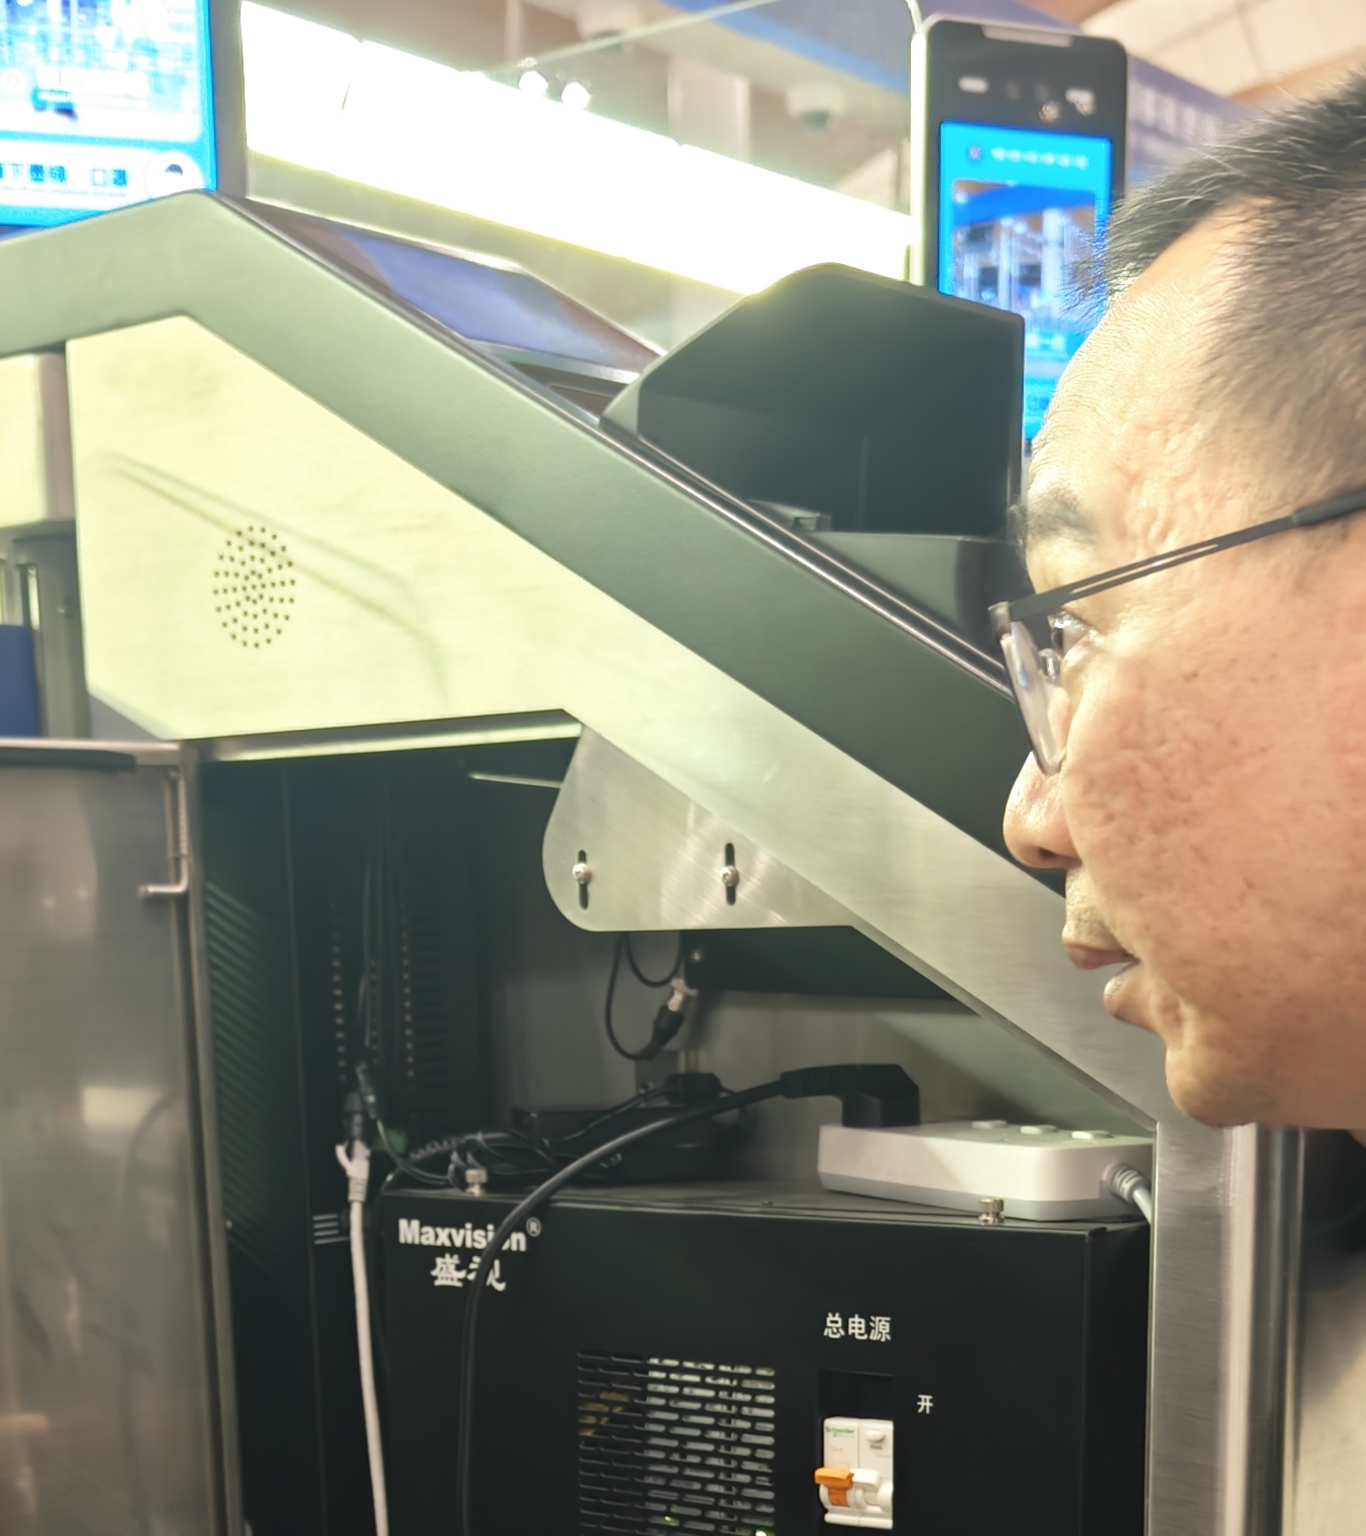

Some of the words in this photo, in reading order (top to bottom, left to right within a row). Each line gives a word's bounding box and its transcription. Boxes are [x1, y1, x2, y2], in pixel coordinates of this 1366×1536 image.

[398, 1218, 527, 1252] Maxvisin
[823, 1312, 892, 1342] 总电源
[916, 1394, 934, 1414] 开
